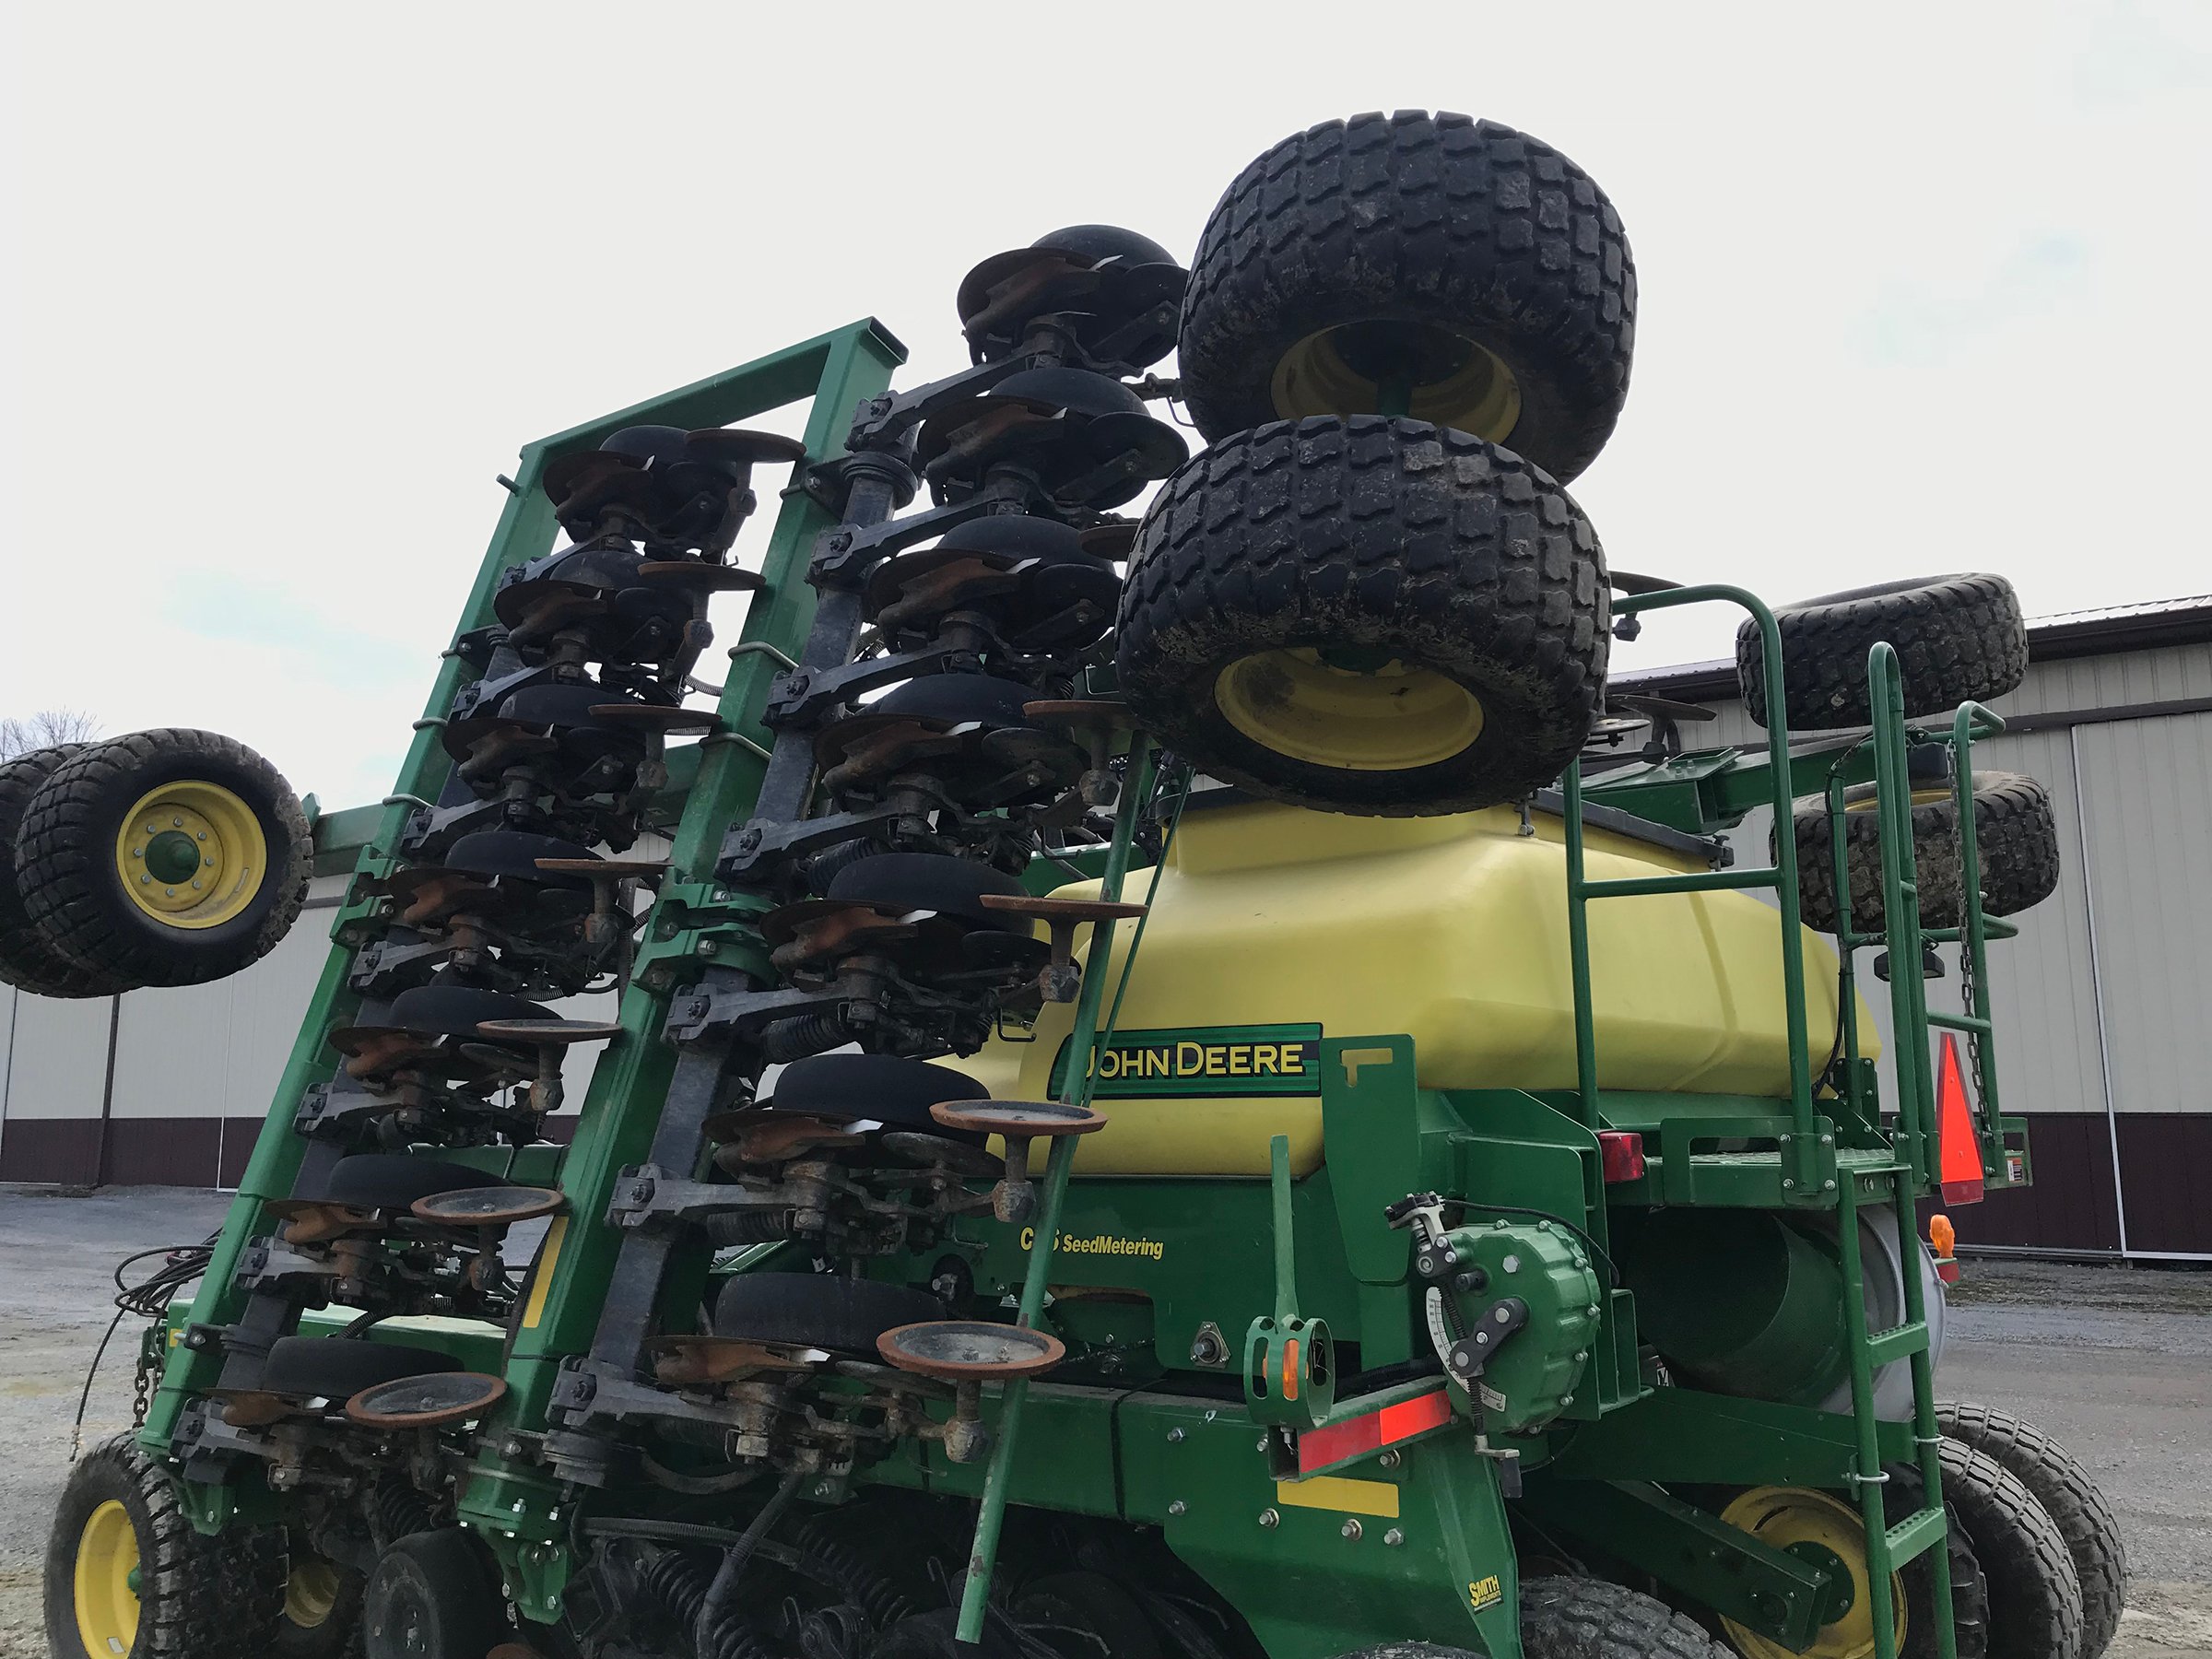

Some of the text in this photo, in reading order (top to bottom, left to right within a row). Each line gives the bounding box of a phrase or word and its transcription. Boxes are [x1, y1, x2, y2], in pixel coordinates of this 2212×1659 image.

[1086, 1041, 1304, 1078] JOHN DEERE
[1062, 1233, 1164, 1260] SeedMetering
[1468, 1573, 1500, 1607] SMITH
